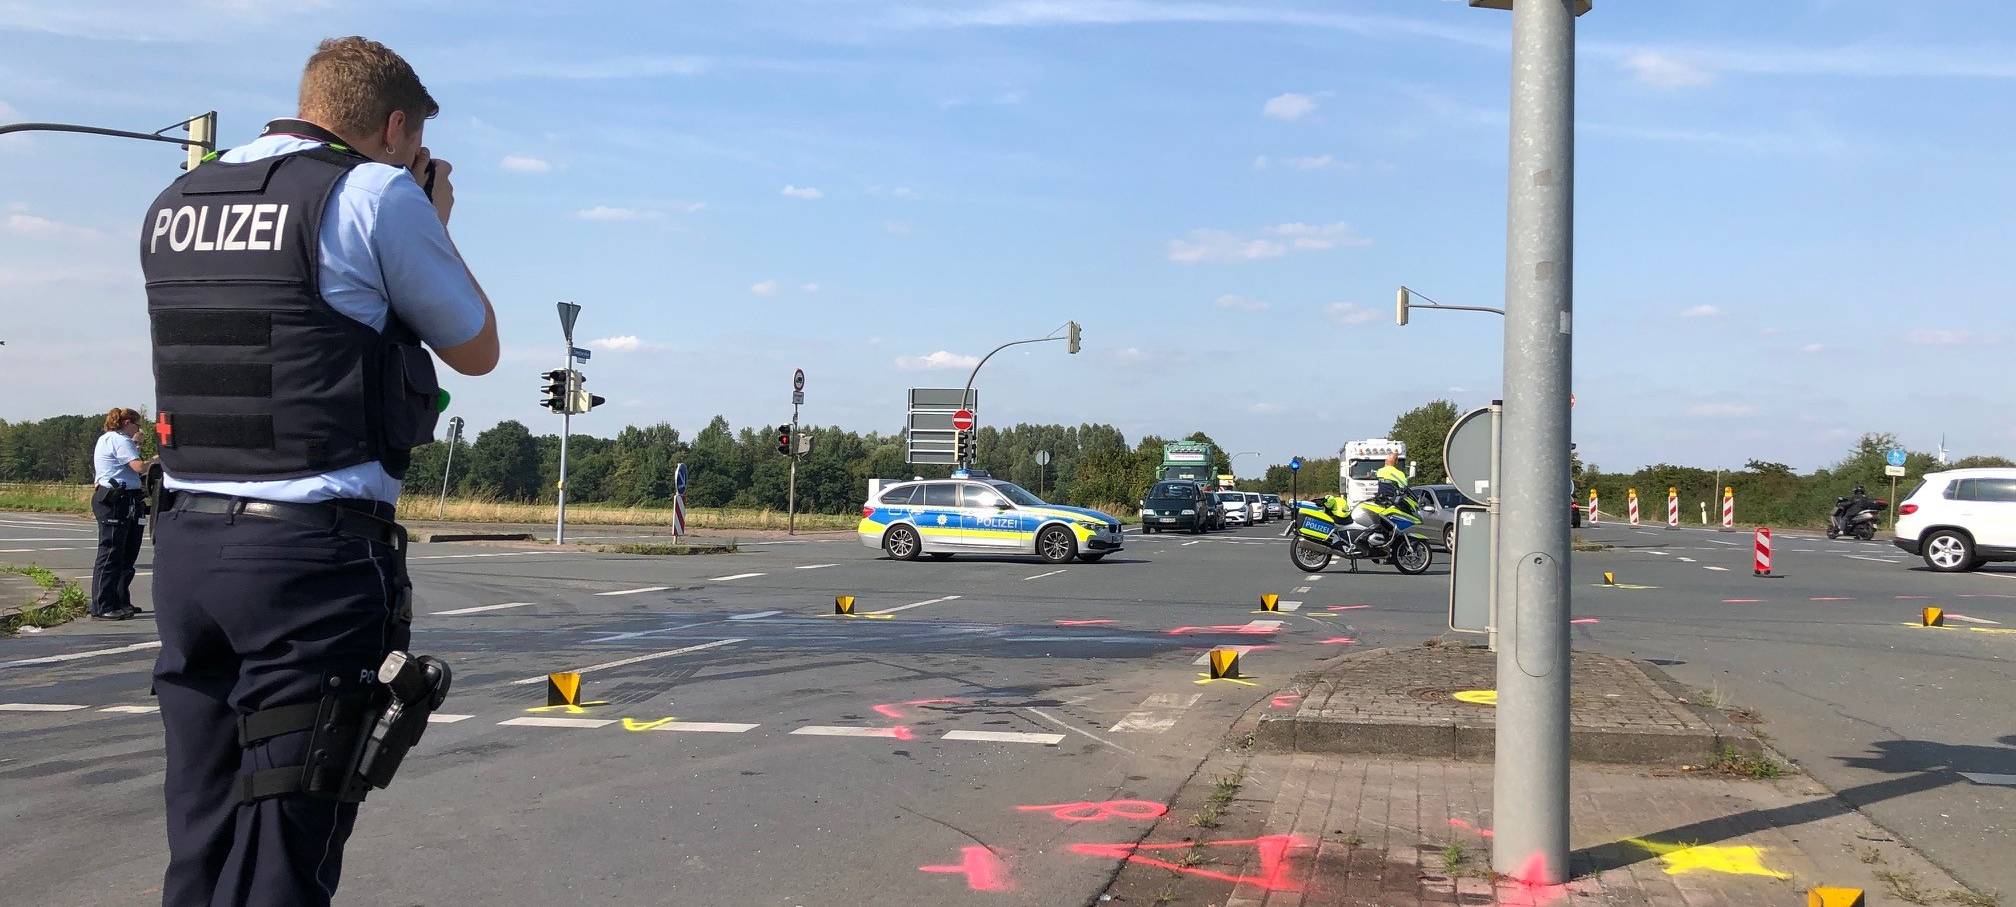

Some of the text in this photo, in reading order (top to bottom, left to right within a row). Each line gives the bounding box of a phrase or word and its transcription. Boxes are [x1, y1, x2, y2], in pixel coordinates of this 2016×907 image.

[151, 204, 289, 254] POLIZEI
[976, 516, 1018, 529] POLIZEI
[1305, 521, 1330, 533] POLIZEI
